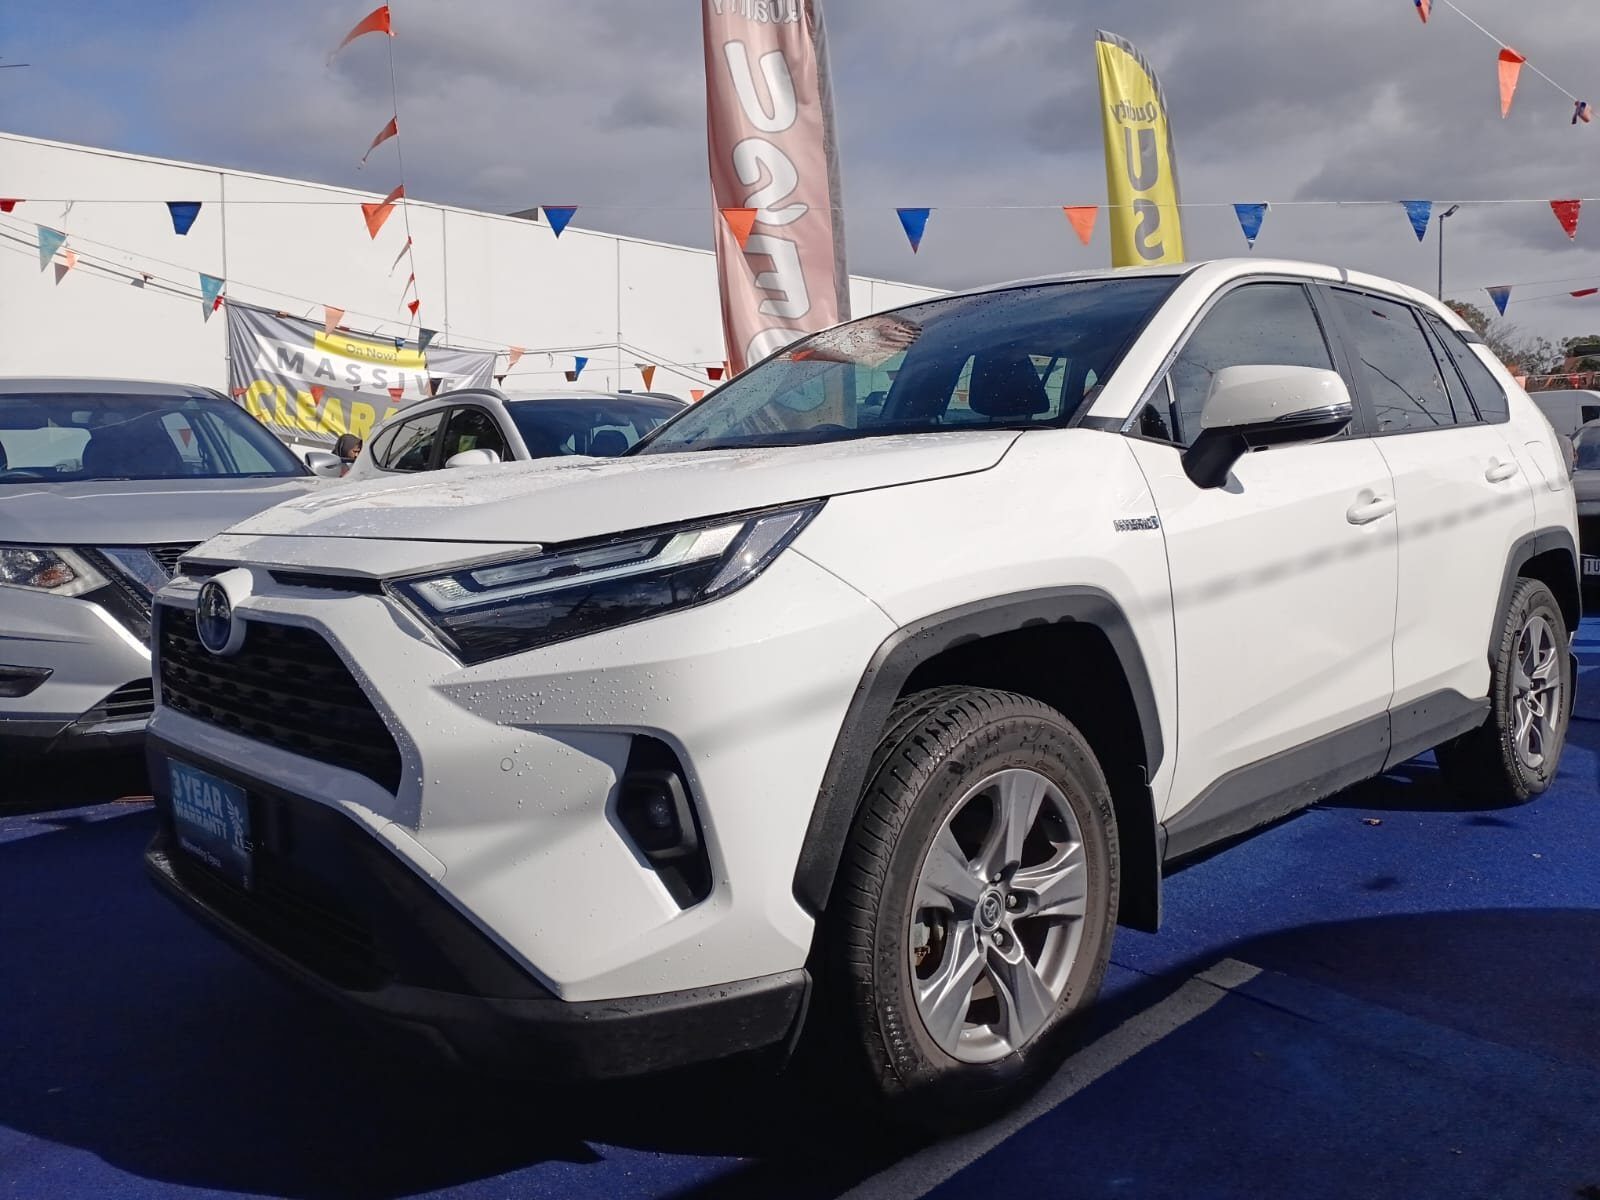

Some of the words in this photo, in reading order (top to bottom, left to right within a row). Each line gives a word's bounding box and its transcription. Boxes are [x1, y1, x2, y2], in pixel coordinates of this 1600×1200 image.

[277, 348, 456, 396] MASSIVE
[346, 343, 363, 357] On
[366, 348, 397, 362] Now!
[172, 769, 182, 798] 3
[180, 773, 223, 817] YEAR
[173, 797, 227, 840] WARRANTY
